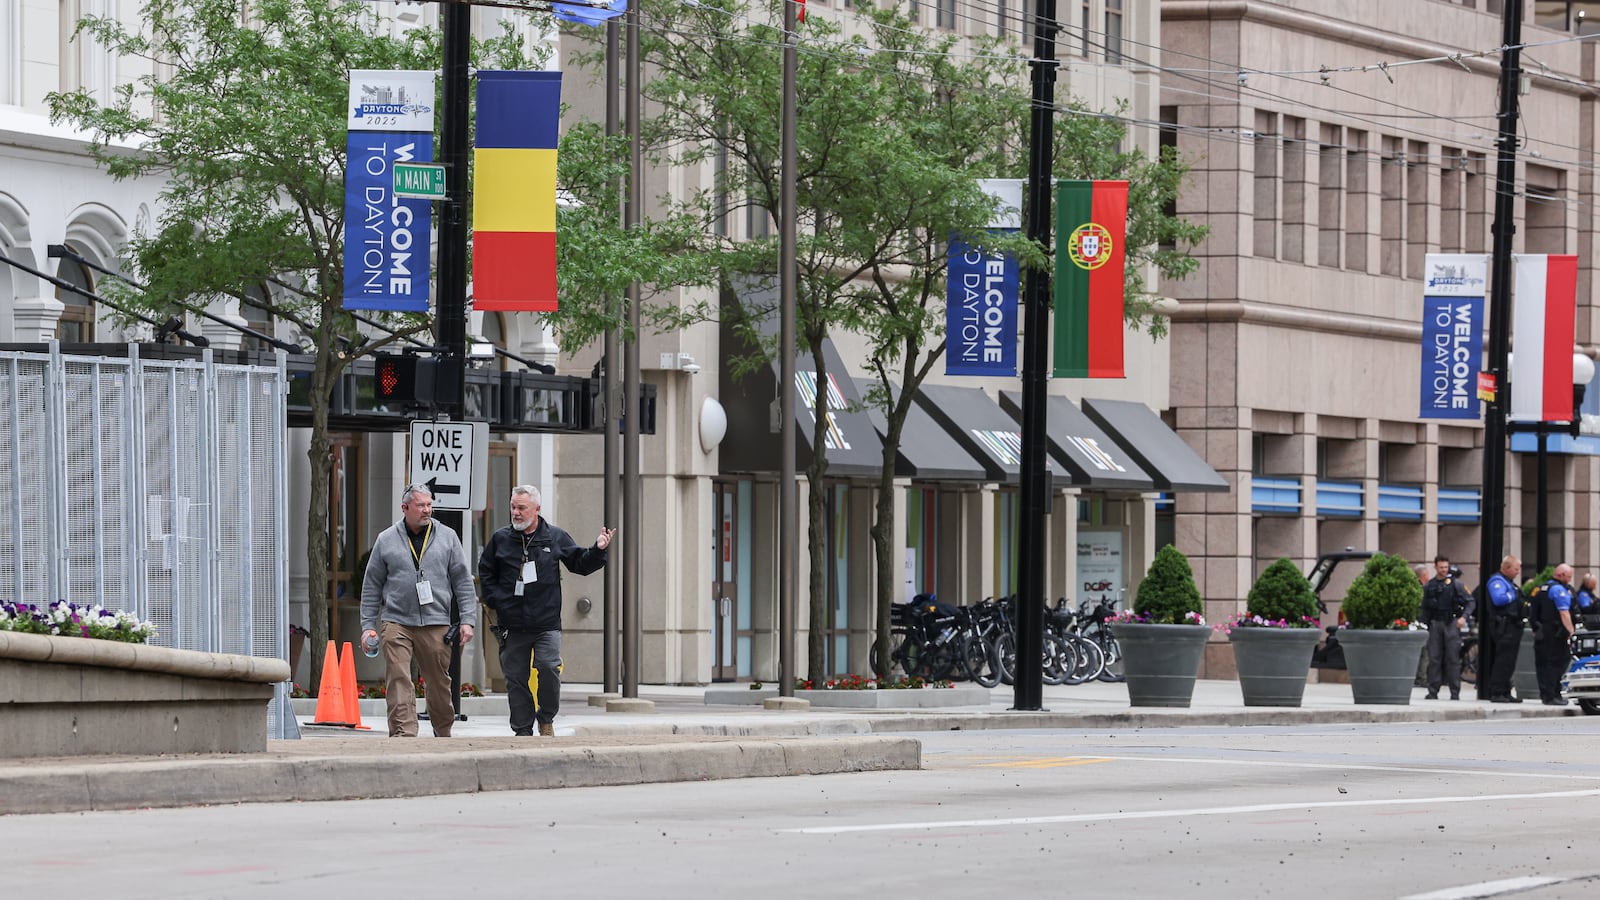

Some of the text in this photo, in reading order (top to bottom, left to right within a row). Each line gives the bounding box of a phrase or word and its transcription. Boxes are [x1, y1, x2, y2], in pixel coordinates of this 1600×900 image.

[363, 105, 400, 113] DAYTON
[366, 116, 397, 126] 2025
[396, 170, 442, 190] N MAIN ST
[434, 183, 444, 194] 100
[363, 142, 386, 294] TO DAYTON!
[390, 142, 415, 295] WCOME
[962, 245, 981, 362] O DAYTON!
[1433, 303, 1452, 409] TO DAYTON!
[1452, 303, 1472, 409] WELCOME
[422, 429, 462, 448] ONE
[421, 452, 463, 472] WAY
